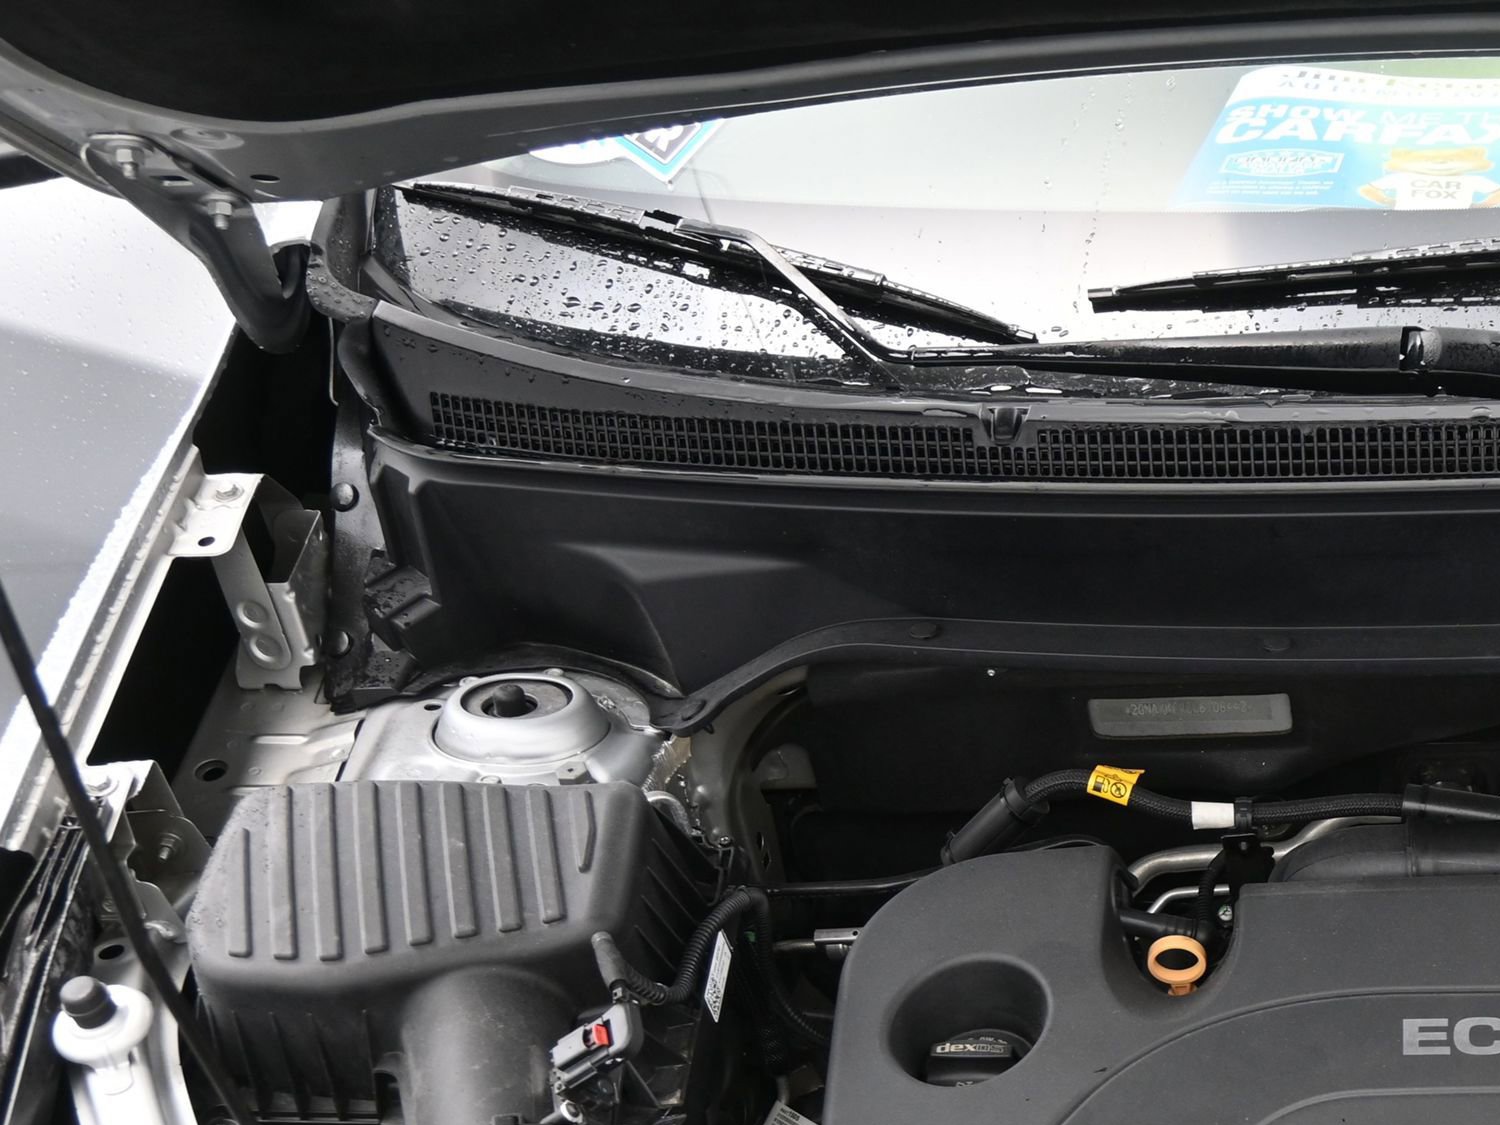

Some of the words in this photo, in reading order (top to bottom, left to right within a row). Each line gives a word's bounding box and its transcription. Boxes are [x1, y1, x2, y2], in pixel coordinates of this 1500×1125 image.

[1226, 104, 1369, 124] SHOW
[1381, 110, 1442, 126] ME
[1409, 178, 1462, 190] CAR
[1409, 190, 1459, 201] FOX
[935, 1042, 1004, 1054] dexos
